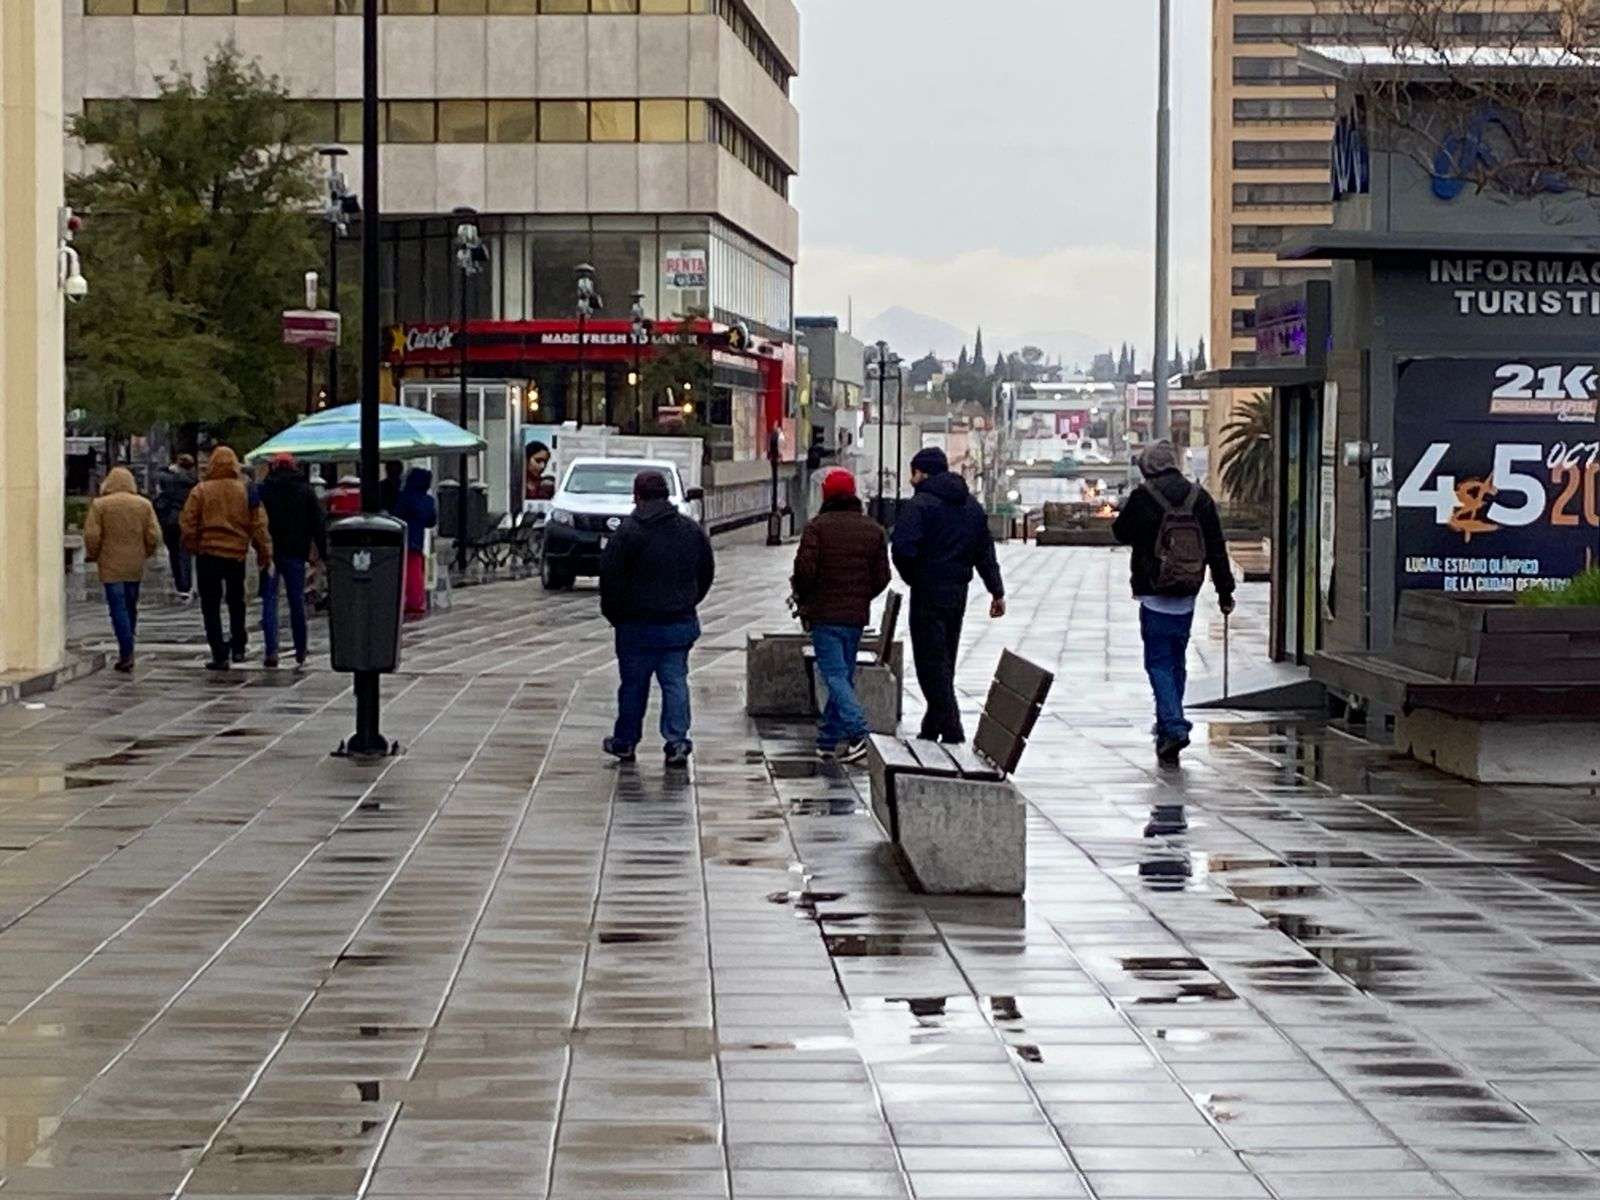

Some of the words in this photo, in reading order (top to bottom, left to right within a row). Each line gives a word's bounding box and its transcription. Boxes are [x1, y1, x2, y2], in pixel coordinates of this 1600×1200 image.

[1454, 290, 1600, 314] TURISTI
[541, 333, 579, 344] MADE
[582, 333, 627, 344] FRESH
[651, 334, 697, 344] ORDR
[1405, 556, 1443, 573] LUGAR:
[1445, 557, 1487, 574] ESTADIO
[1444, 576, 1458, 592] DE
[1460, 576, 1475, 592] LA
[1476, 577, 1514, 592] CIUDAD
